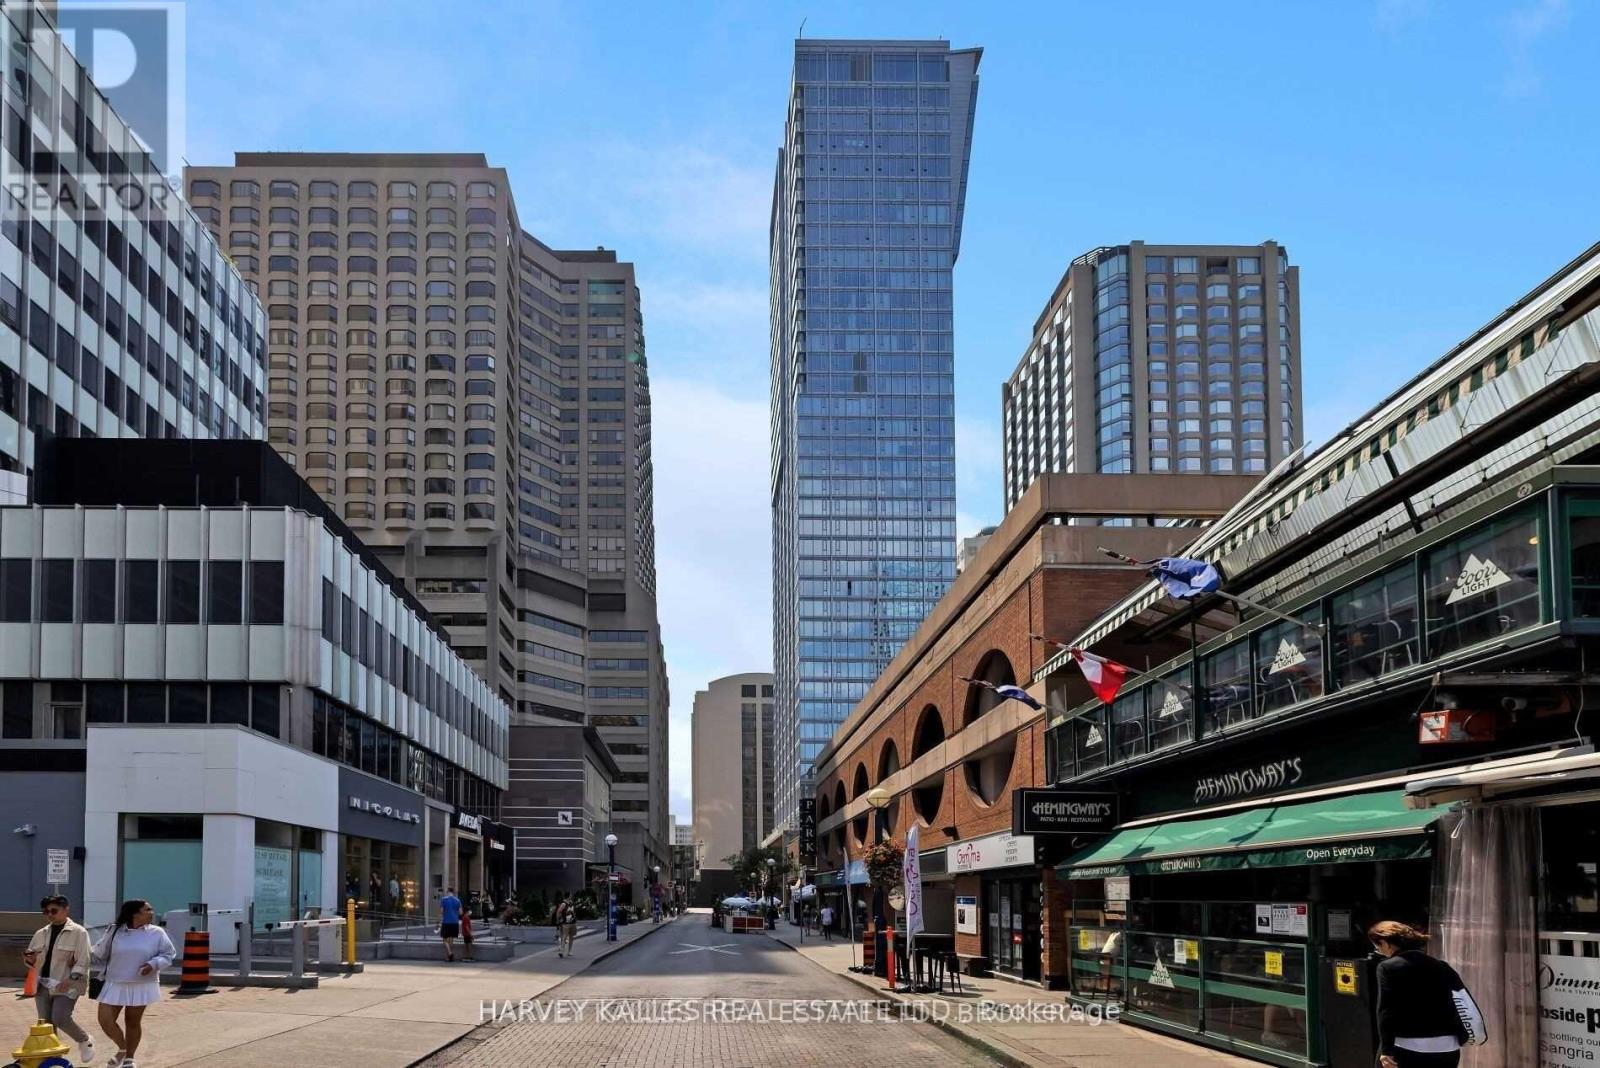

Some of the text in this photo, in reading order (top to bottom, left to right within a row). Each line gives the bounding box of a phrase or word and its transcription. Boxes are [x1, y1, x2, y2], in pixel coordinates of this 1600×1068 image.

[1456, 566, 1498, 589] Coors
[1462, 578, 1490, 596] LIGHT
[1274, 647, 1299, 663] Coors
[1278, 657, 1295, 669] LIGHT
[1194, 757, 1302, 803] HEMINGWAY'S
[351, 797, 421, 824] NICOLAS
[1032, 802, 1111, 816] HEMINGWAY'S
[805, 800, 815, 853] PARK
[1306, 845, 1375, 860] Open Everyday
[1540, 1040, 1594, 1060] Sangria
